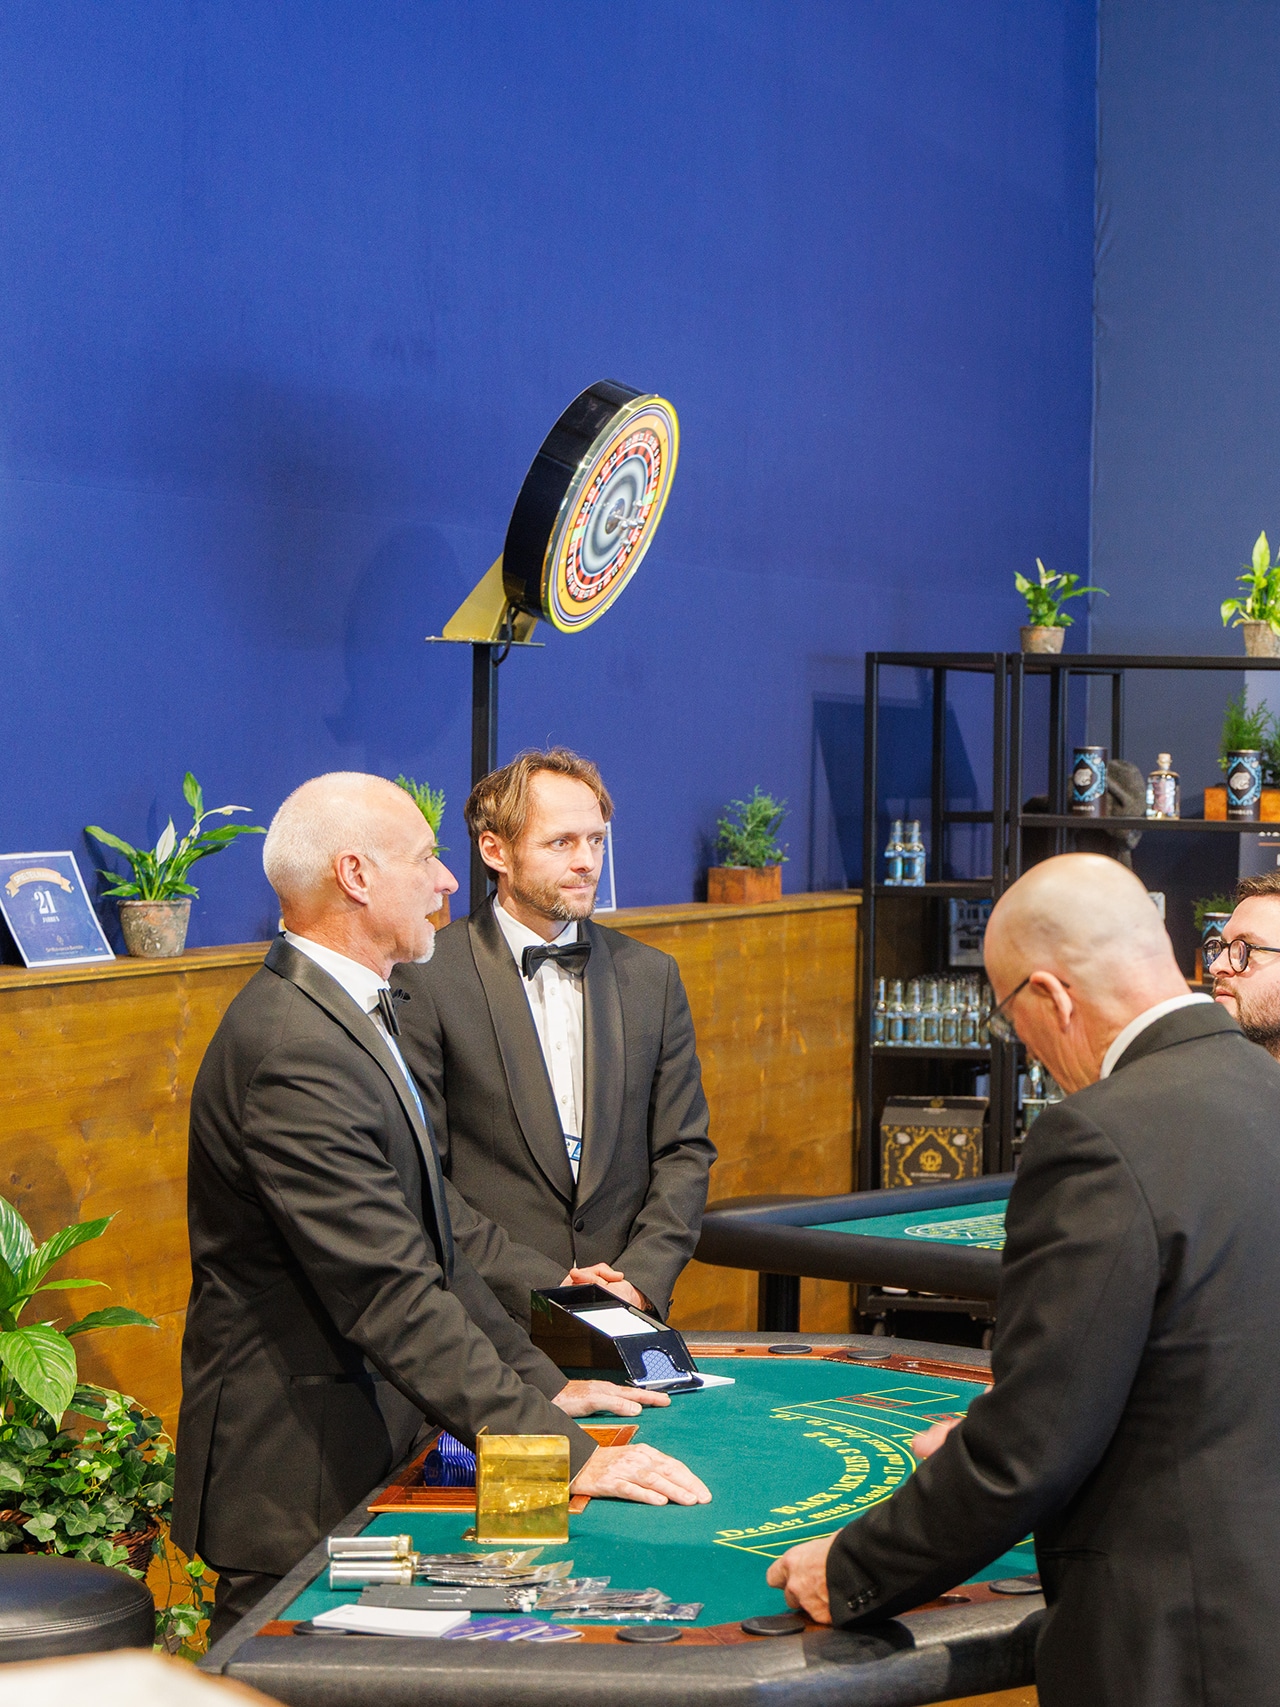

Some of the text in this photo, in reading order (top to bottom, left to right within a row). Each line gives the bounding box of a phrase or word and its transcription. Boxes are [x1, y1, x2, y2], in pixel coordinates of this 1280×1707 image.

[33, 890, 57, 915] 21
[818, 1438, 850, 1448] TO
[843, 1455, 870, 1472] PAYS
[876, 1454, 905, 1465] and
[883, 1466, 906, 1475] 17
[828, 1474, 868, 1492] JACK
[883, 1476, 902, 1485] on
[853, 1484, 894, 1504] stand
[770, 1491, 843, 1515] BLACK
[808, 1502, 857, 1519] must
[716, 1517, 804, 1537] Dealer
